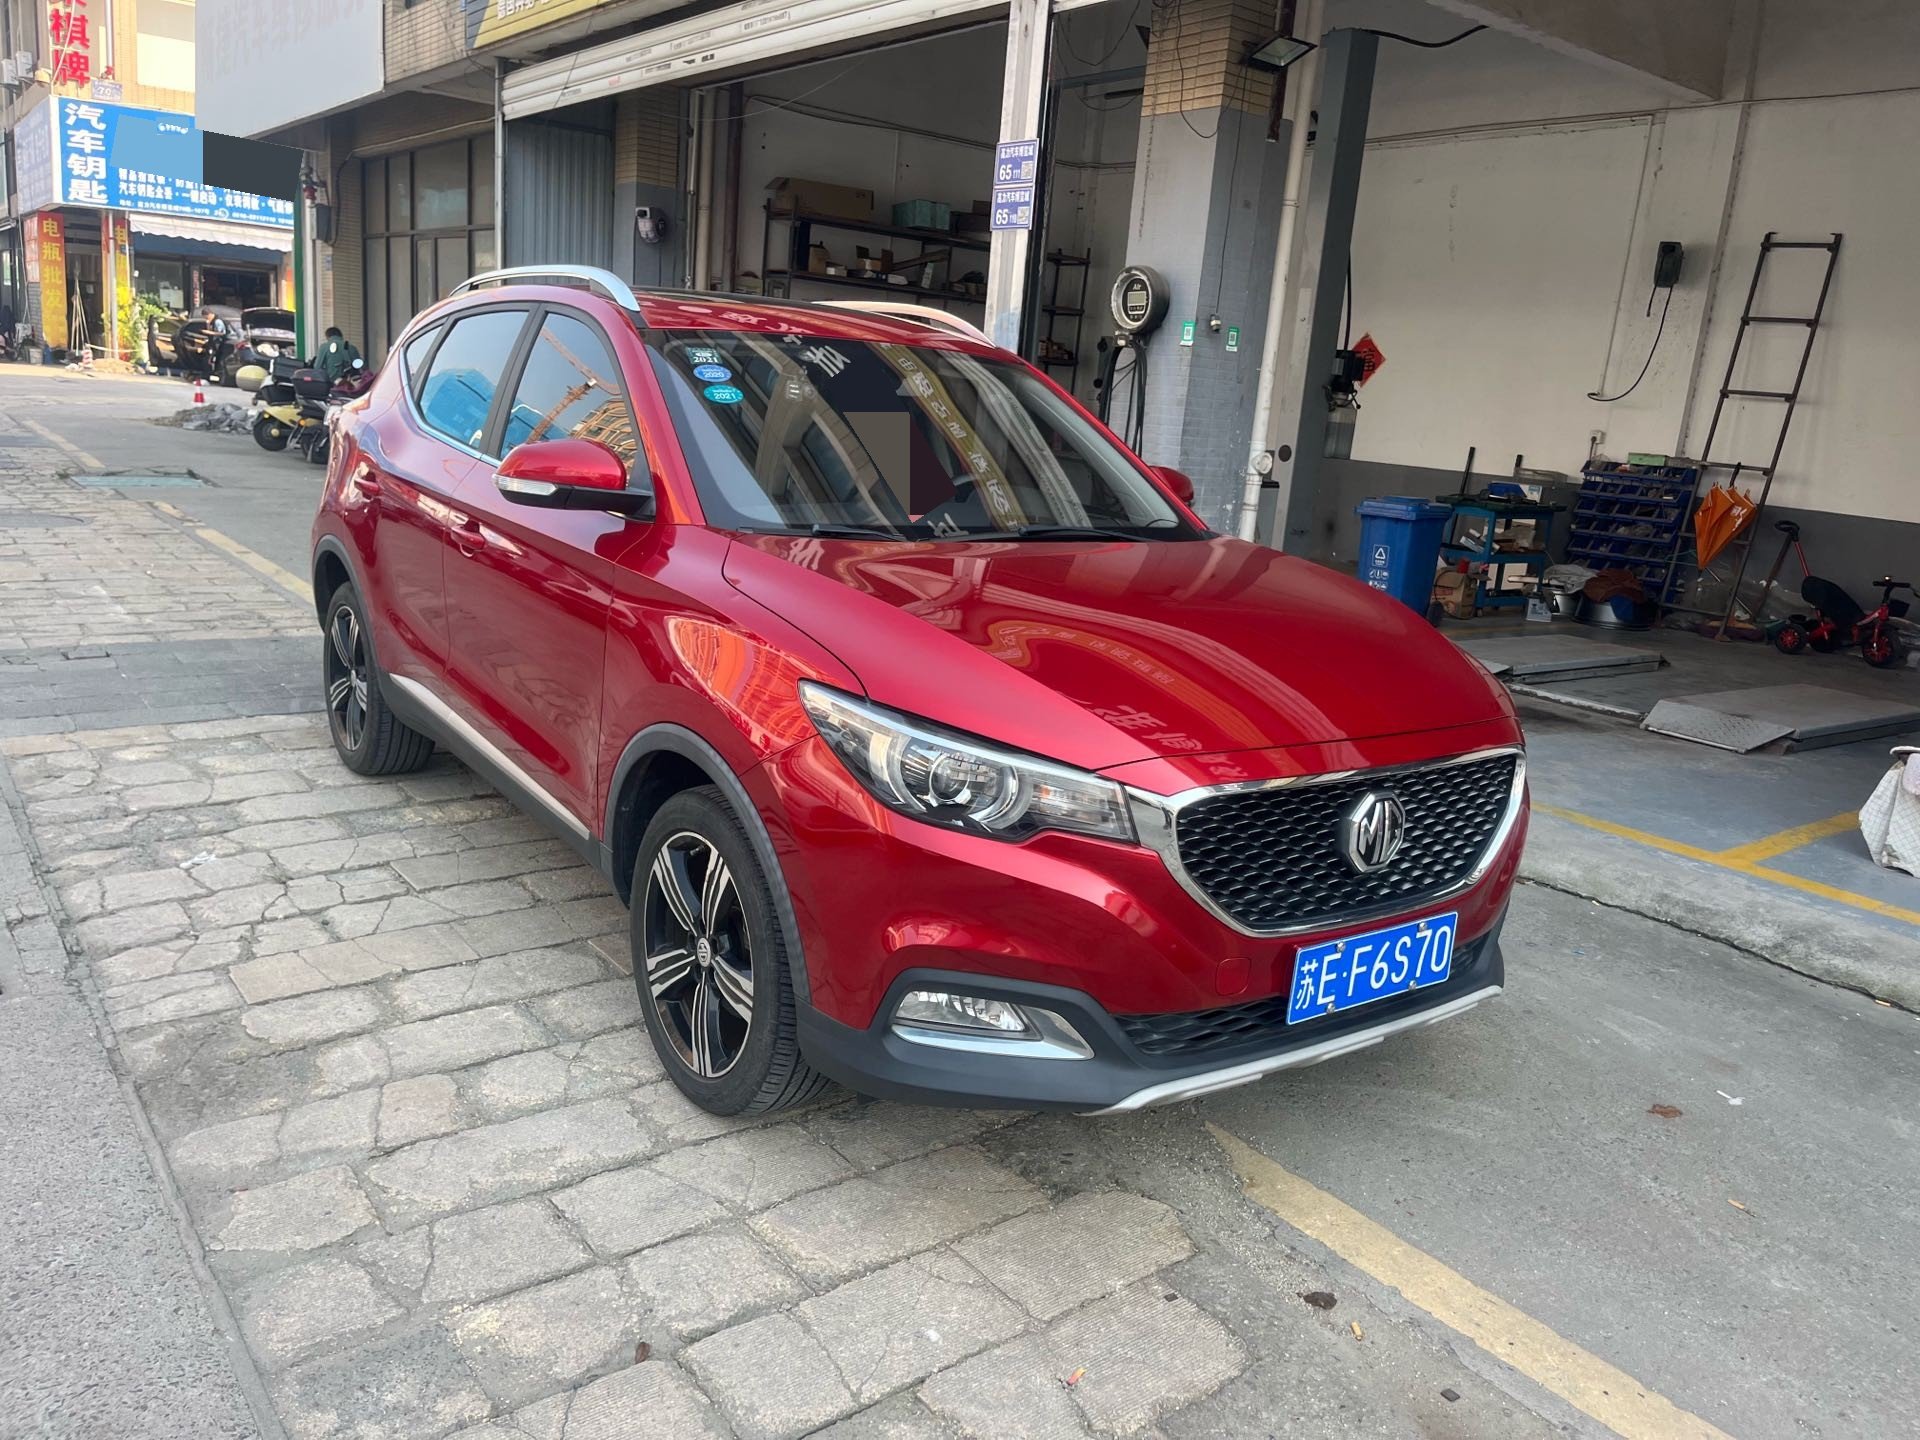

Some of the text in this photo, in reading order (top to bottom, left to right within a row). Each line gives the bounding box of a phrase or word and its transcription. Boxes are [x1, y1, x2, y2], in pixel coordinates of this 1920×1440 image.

[51, 0, 90, 88] 棋牌
[64, 103, 108, 205] 汽车钥匙
[999, 165, 1012, 181] 65
[995, 209, 1008, 225] 65
[713, 392, 737, 400] 2021
